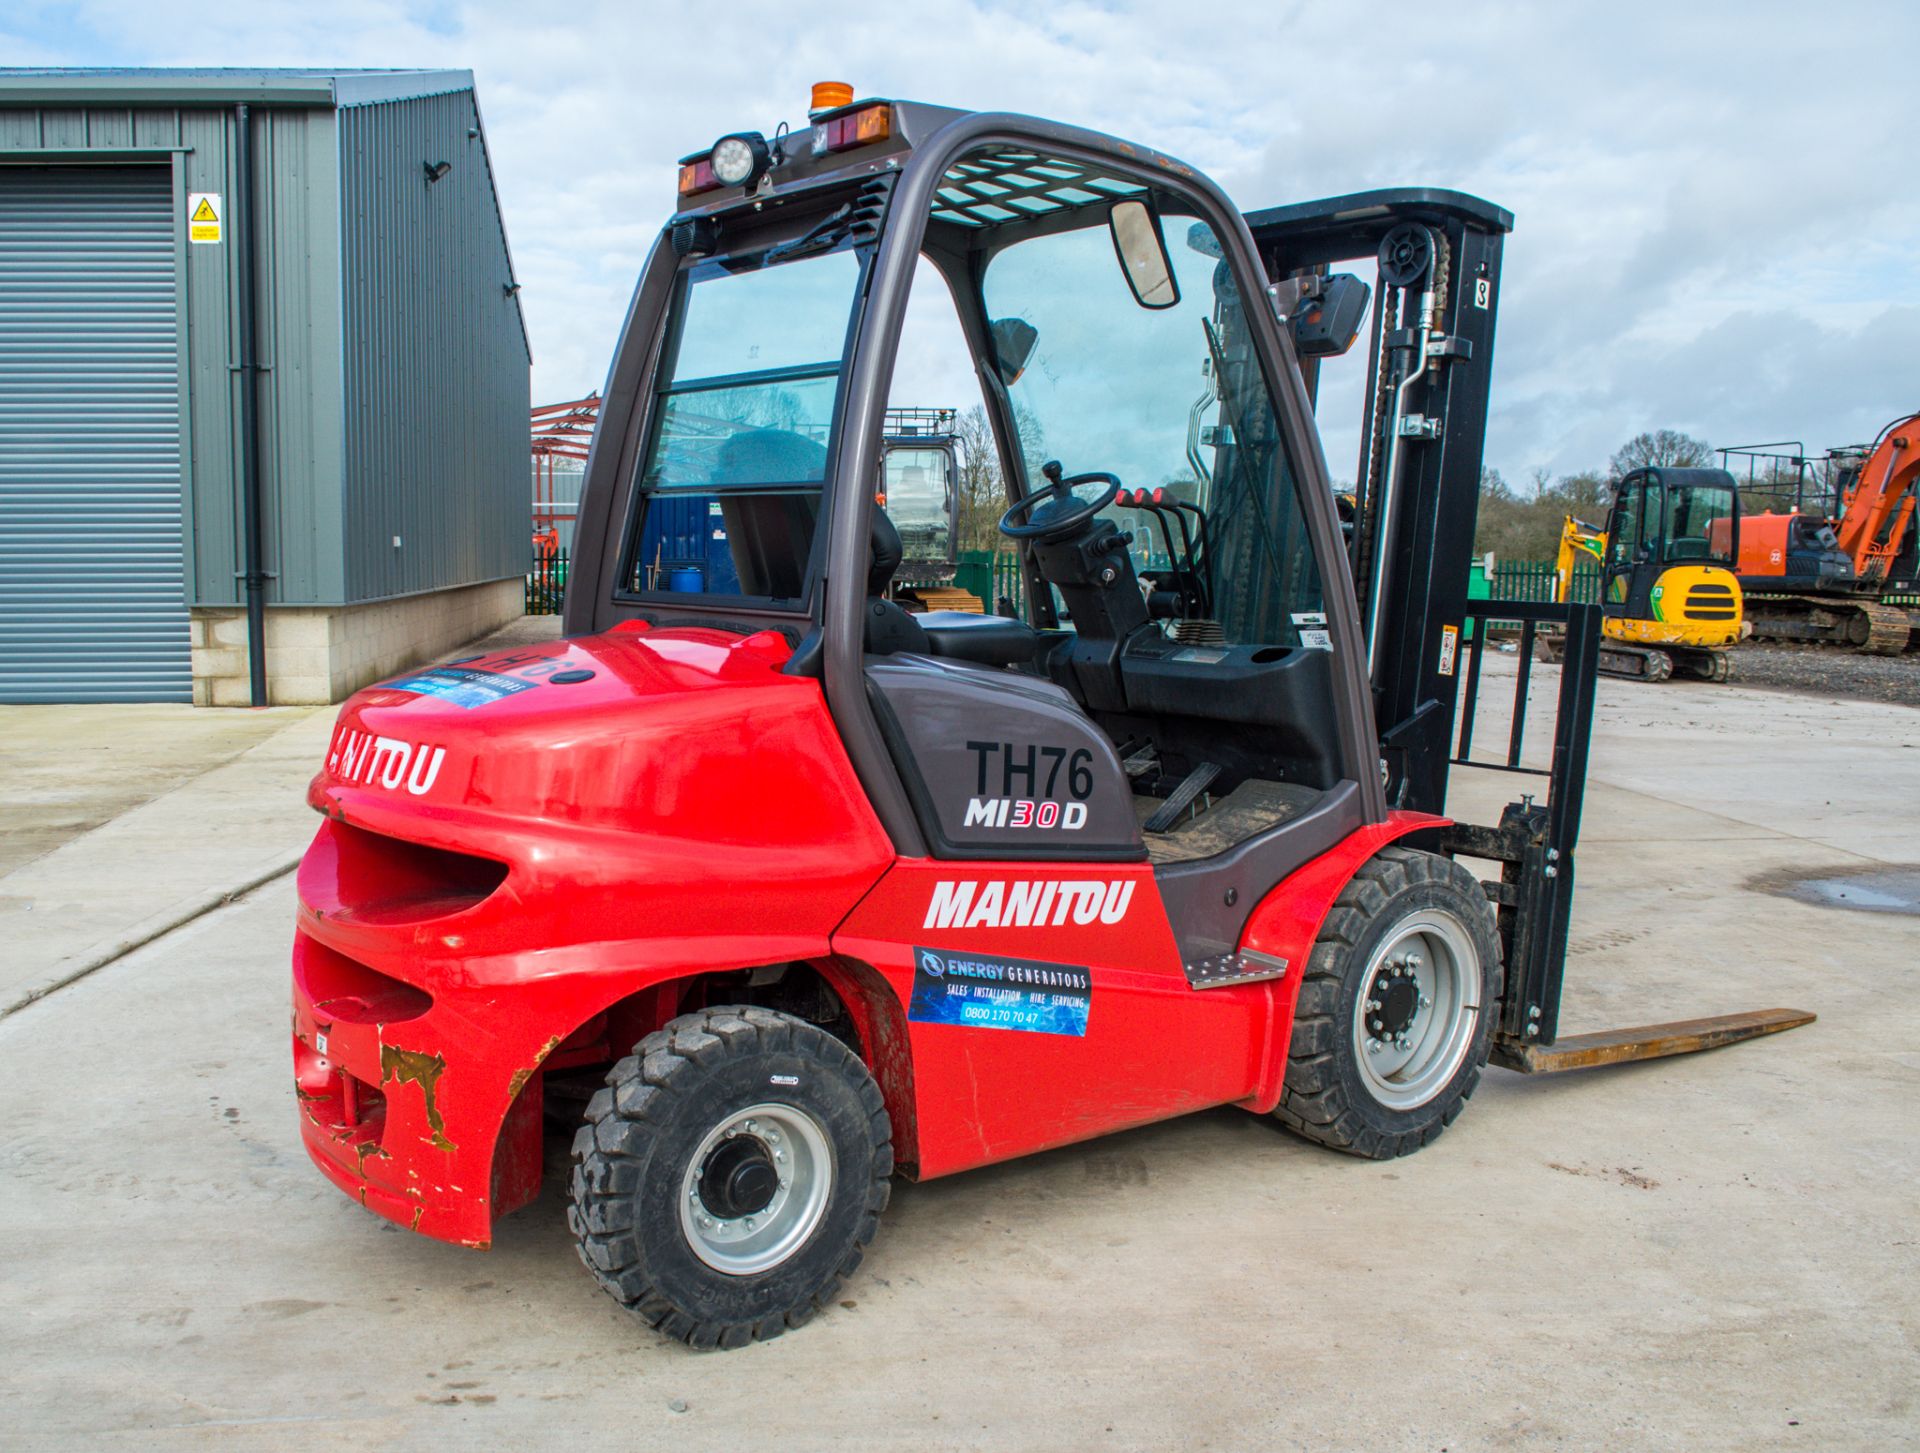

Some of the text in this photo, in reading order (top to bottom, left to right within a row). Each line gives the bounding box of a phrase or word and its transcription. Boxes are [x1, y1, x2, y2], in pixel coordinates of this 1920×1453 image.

[967, 741, 1093, 801] TH76
[923, 880, 1137, 929] MANITOU
[948, 960, 1086, 989] ENERGY GENERATORS
[947, 983, 1085, 1008] SALES INSTALLATION HIRE SERVICING
[965, 1007, 1038, 1024] 0800 170 70 47
